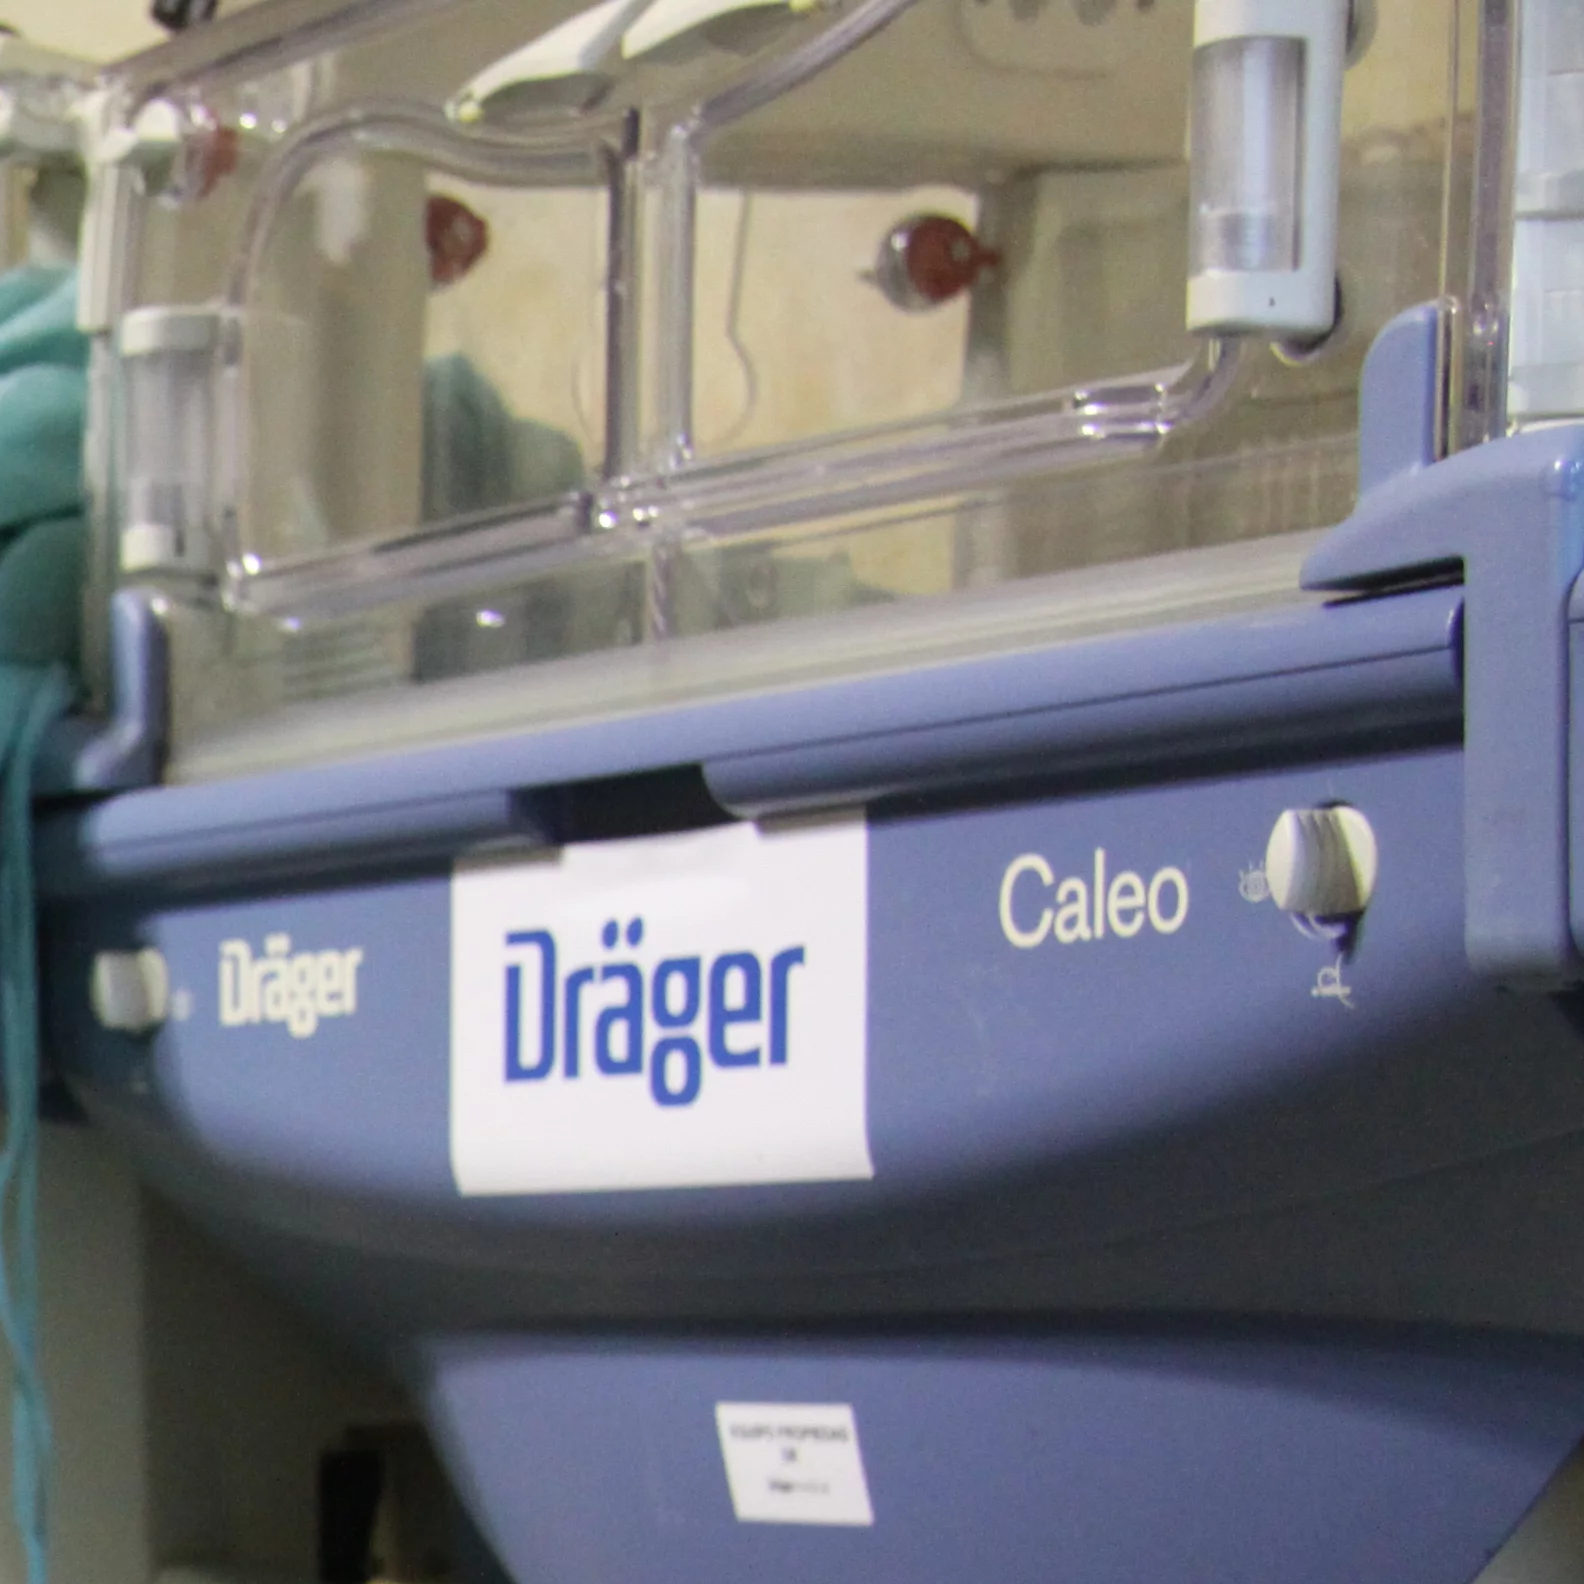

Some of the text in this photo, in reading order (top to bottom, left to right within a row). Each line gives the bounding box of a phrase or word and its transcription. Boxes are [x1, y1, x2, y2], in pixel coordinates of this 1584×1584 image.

[998, 848, 1189, 949] Caleo
[219, 934, 362, 1037] Dräger
[503, 917, 806, 1107] Dräger
